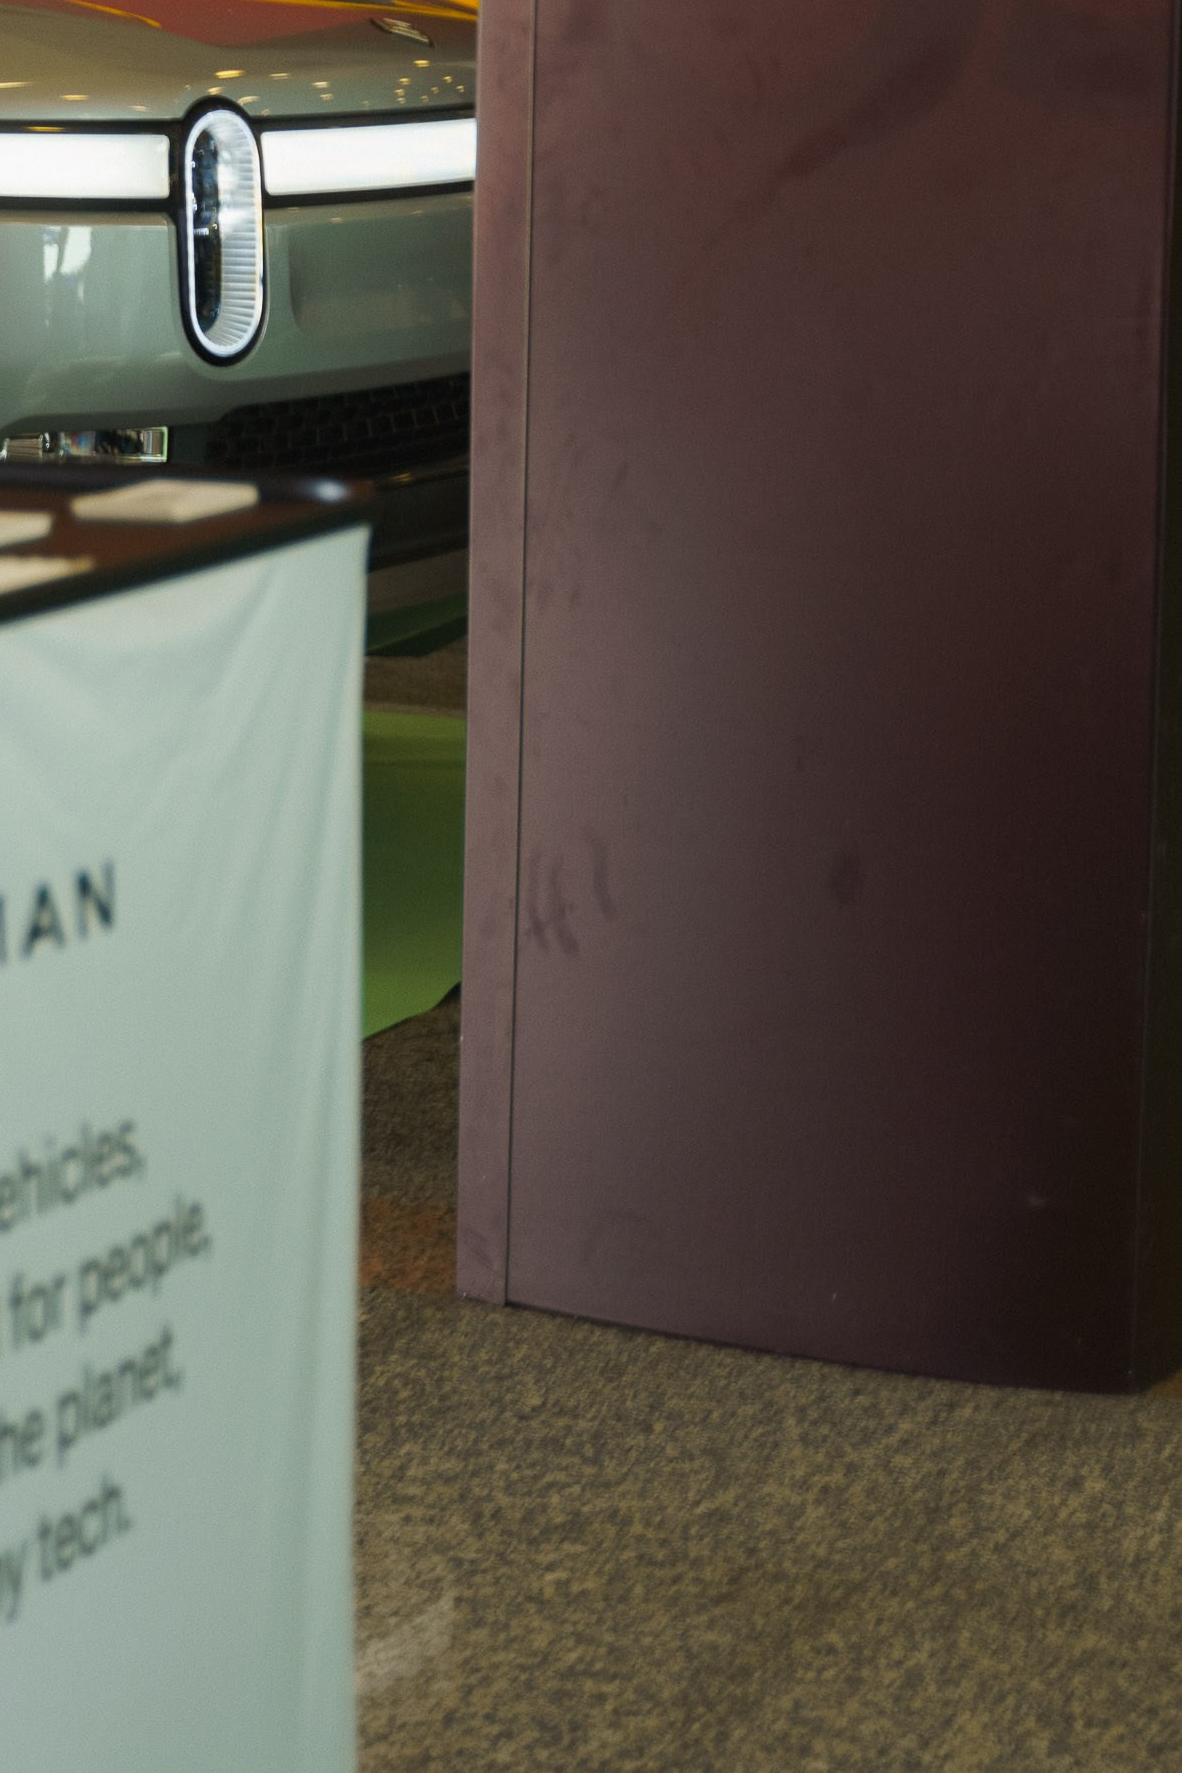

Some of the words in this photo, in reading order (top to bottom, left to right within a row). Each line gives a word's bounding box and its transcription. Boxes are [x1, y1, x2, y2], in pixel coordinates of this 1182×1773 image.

[9, 1269, 67, 1348] for
[80, 1190, 212, 1337] people,
[38, 1472, 134, 1584] tech.
